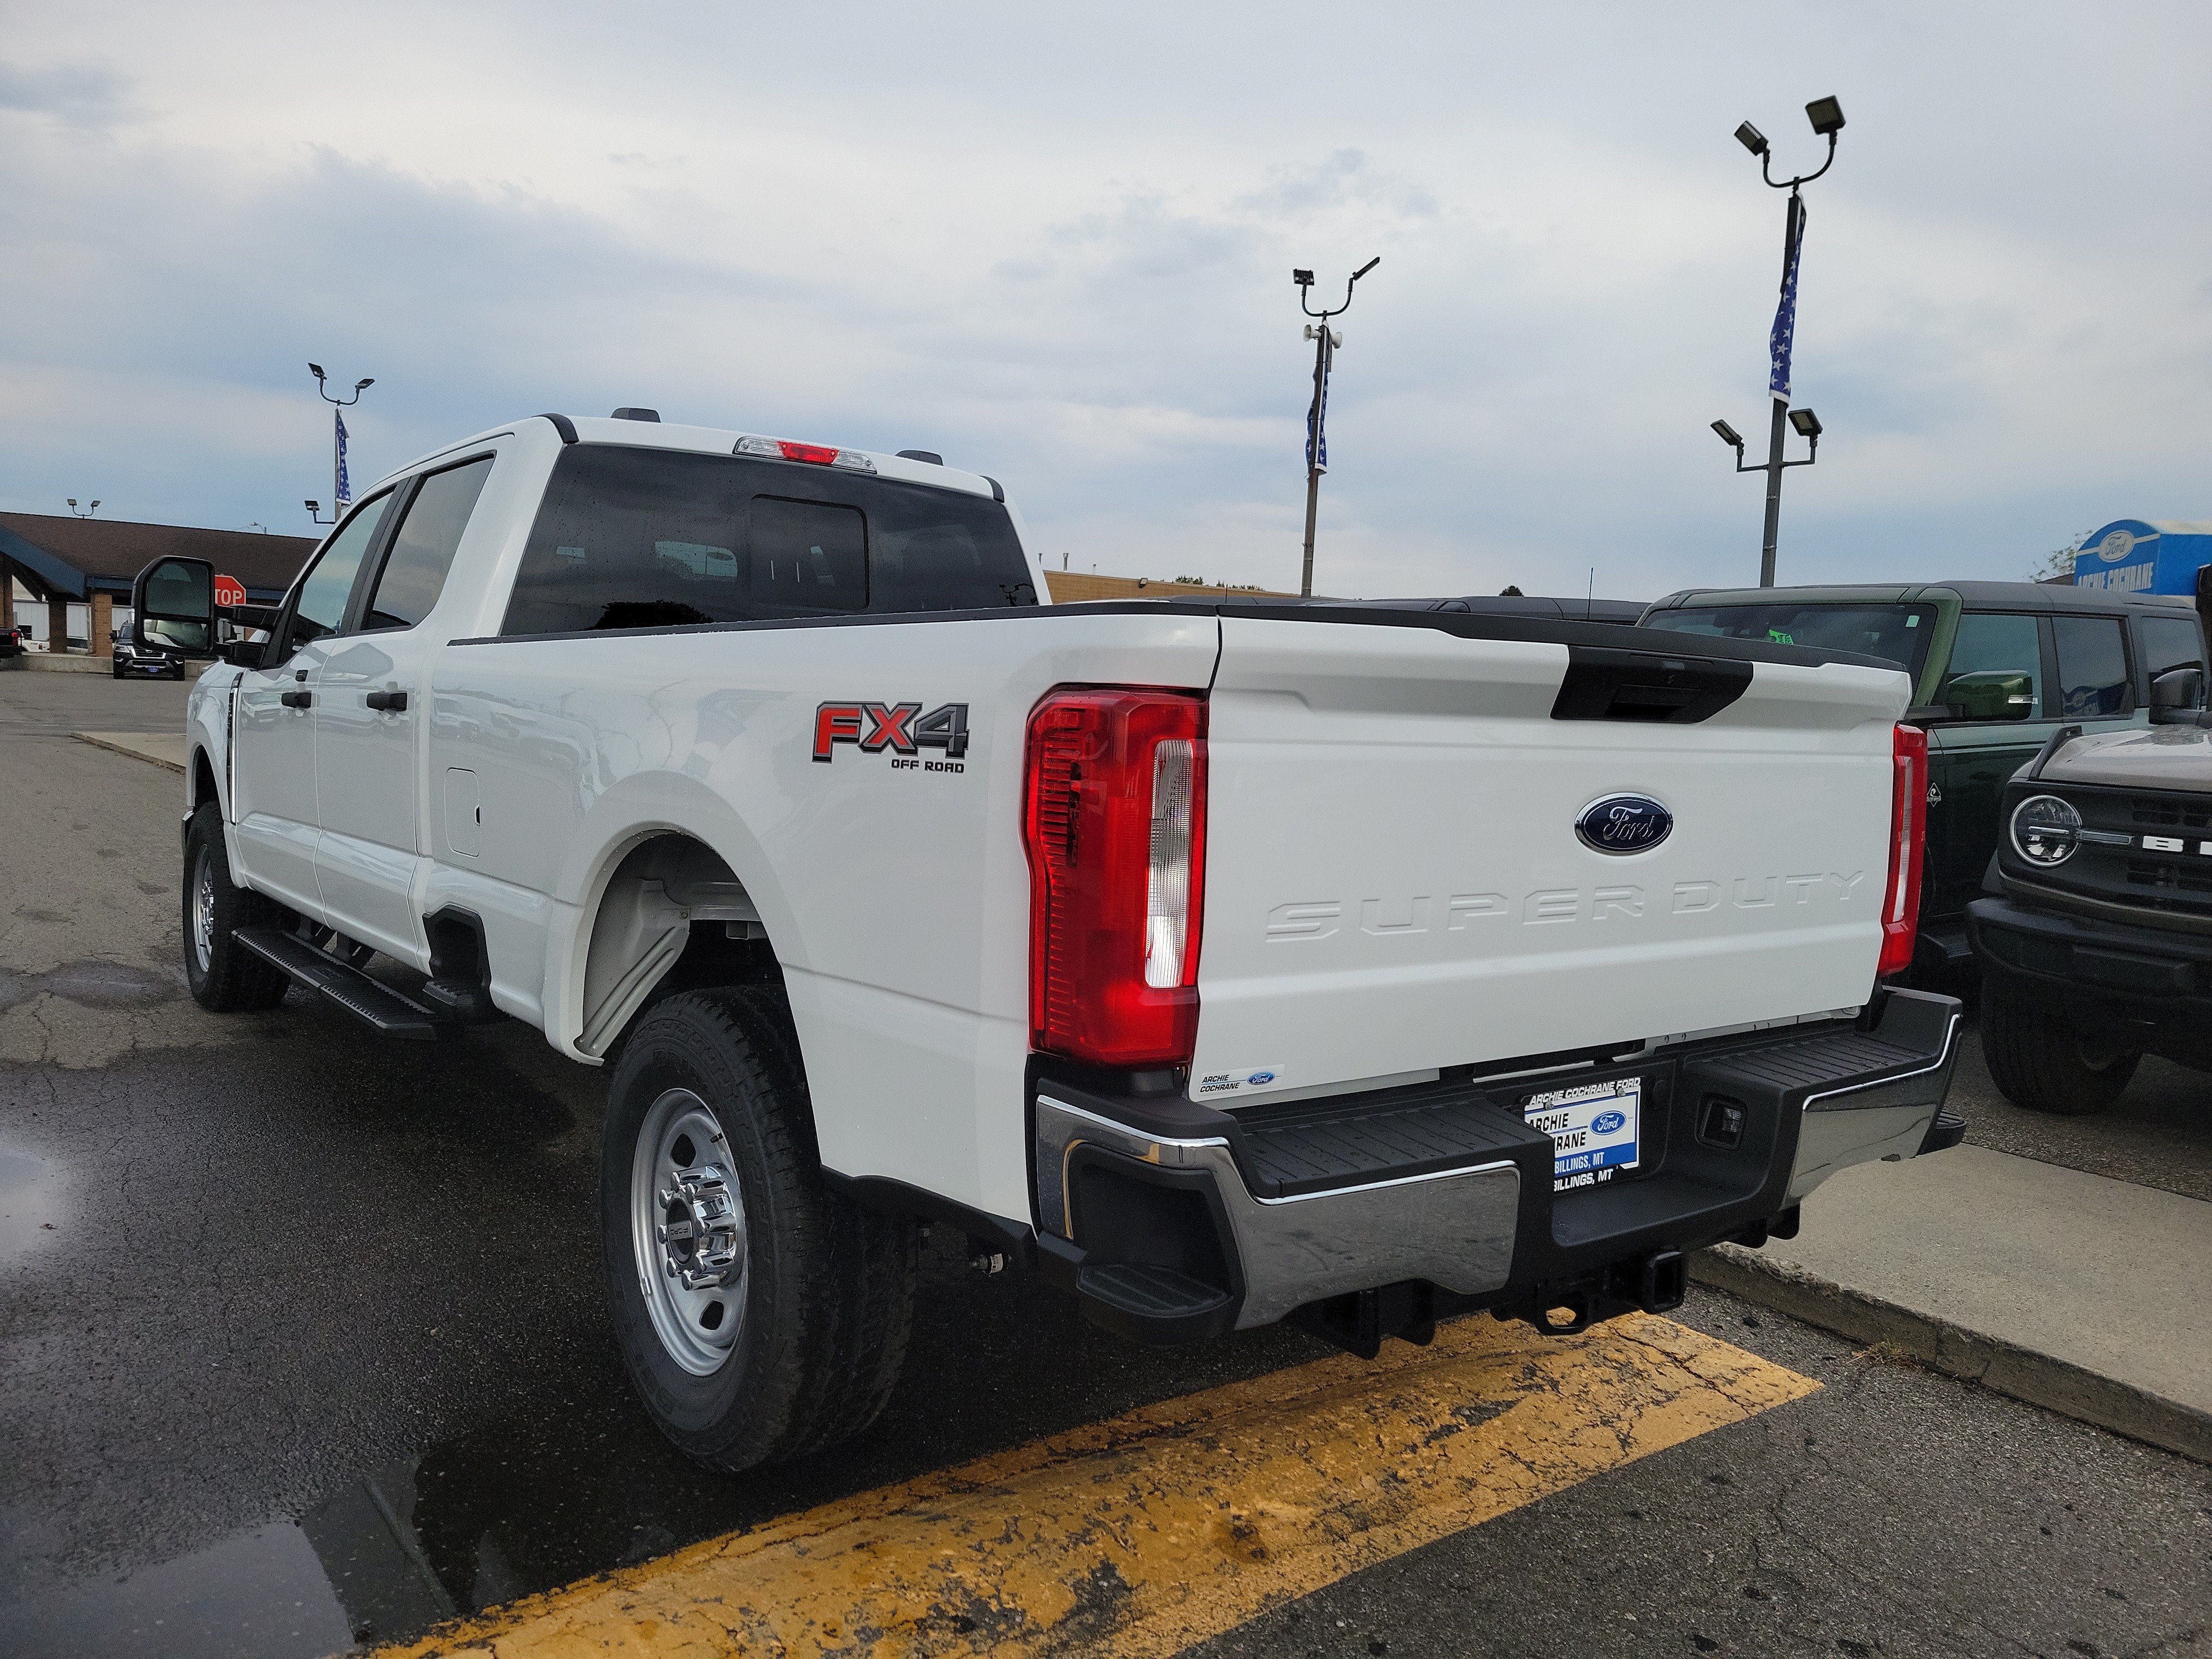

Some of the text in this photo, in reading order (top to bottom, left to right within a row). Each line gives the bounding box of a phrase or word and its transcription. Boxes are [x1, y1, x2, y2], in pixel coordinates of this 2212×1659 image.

[2105, 536, 2127, 555] Ford
[2107, 562, 2154, 592] COCHRANE
[215, 589, 242, 605] TOP
[812, 701, 970, 764] FX4
[891, 758, 965, 774] OFF ROAD
[1603, 805, 1656, 840] Ford
[1265, 870, 1864, 944] SUPER DUTY
[1200, 1082, 1240, 1093] COCHRANE
[1201, 1074, 1230, 1084] ARCHIE
[1251, 1074, 1270, 1084] Ford
[1528, 1077, 1641, 1105] ARCHIE COCHRANE FORD
[1596, 1114, 1620, 1132] Ford
[1554, 1131, 1587, 1152] RANE
[1554, 1152, 1605, 1174] BILLINGS, MT
[1598, 1169, 1614, 1182] MT
